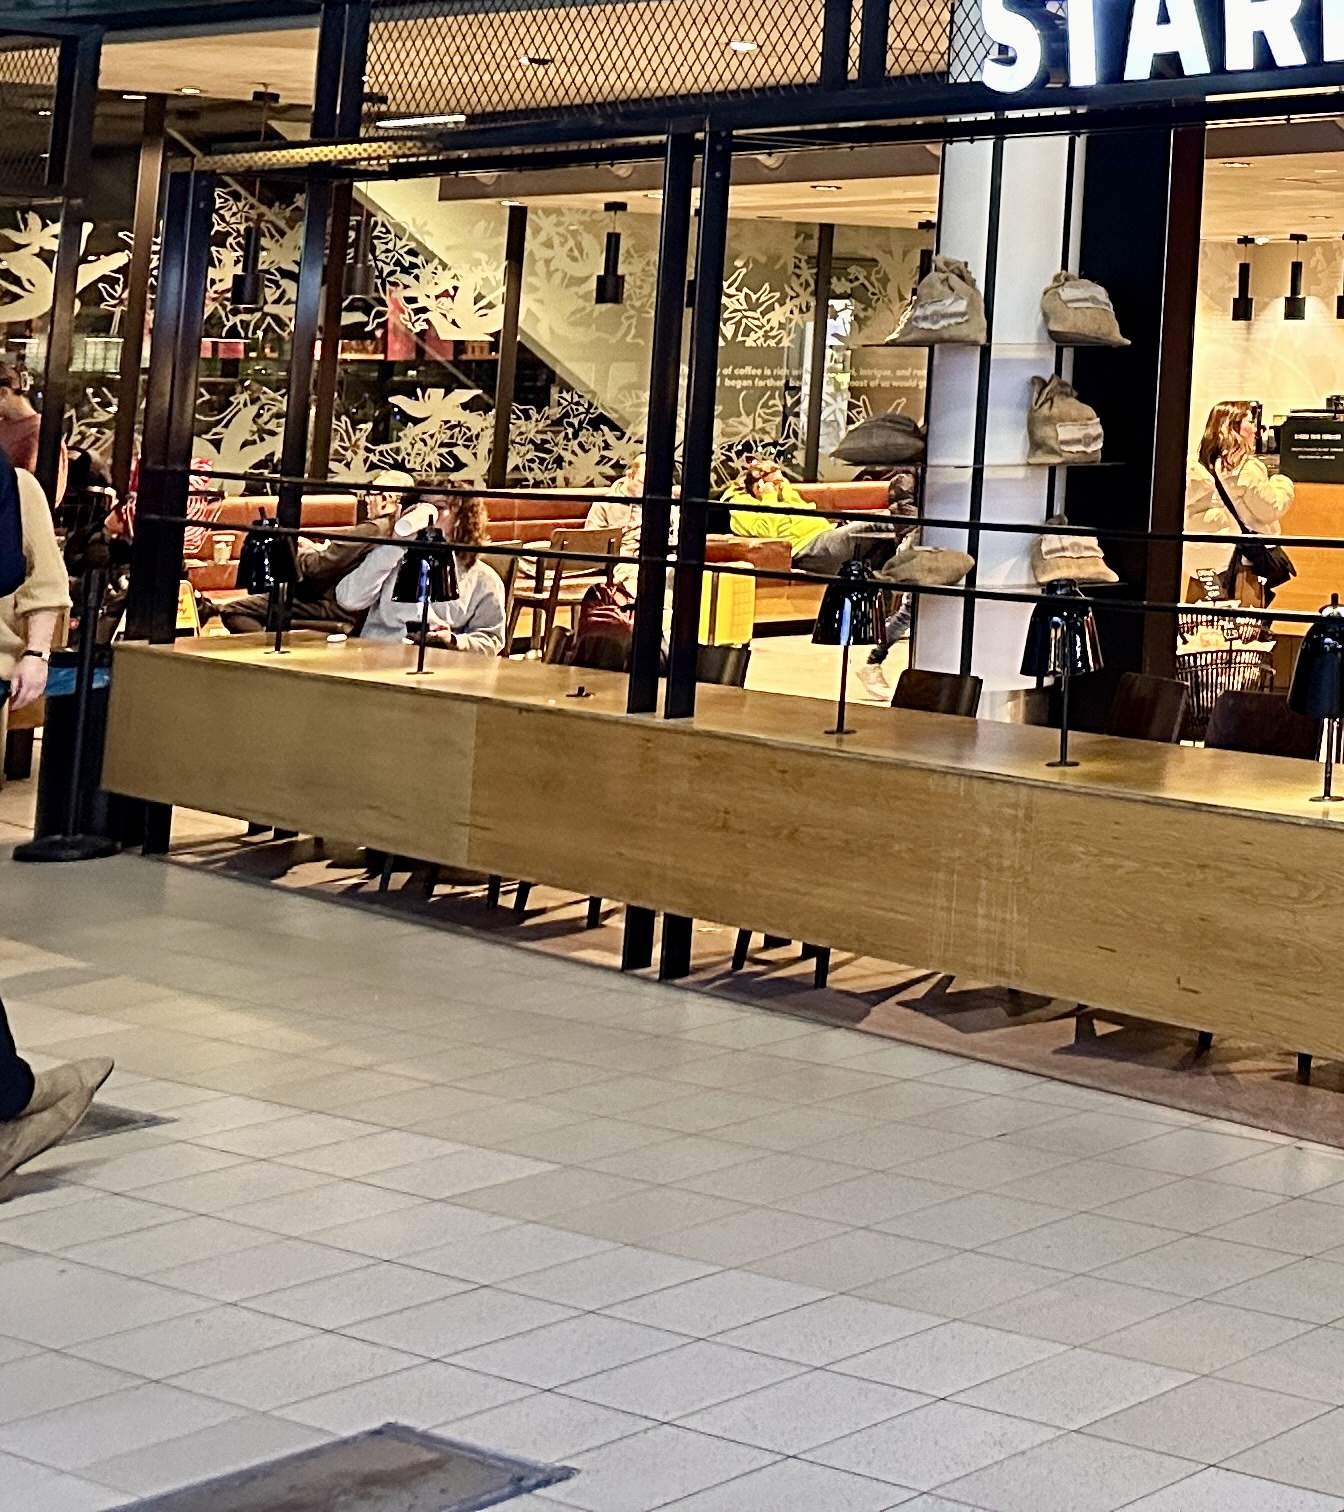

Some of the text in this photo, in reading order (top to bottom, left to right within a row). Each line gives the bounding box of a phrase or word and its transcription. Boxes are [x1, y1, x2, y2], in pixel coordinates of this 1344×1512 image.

[721, 365, 733, 376] of
[733, 365, 762, 376] coffee
[763, 366, 771, 376] is
[895, 367, 912, 376] and
[724, 377, 753, 389] began
[754, 377, 785, 387] farther
[869, 378, 880, 388] of
[891, 378, 918, 388] would
